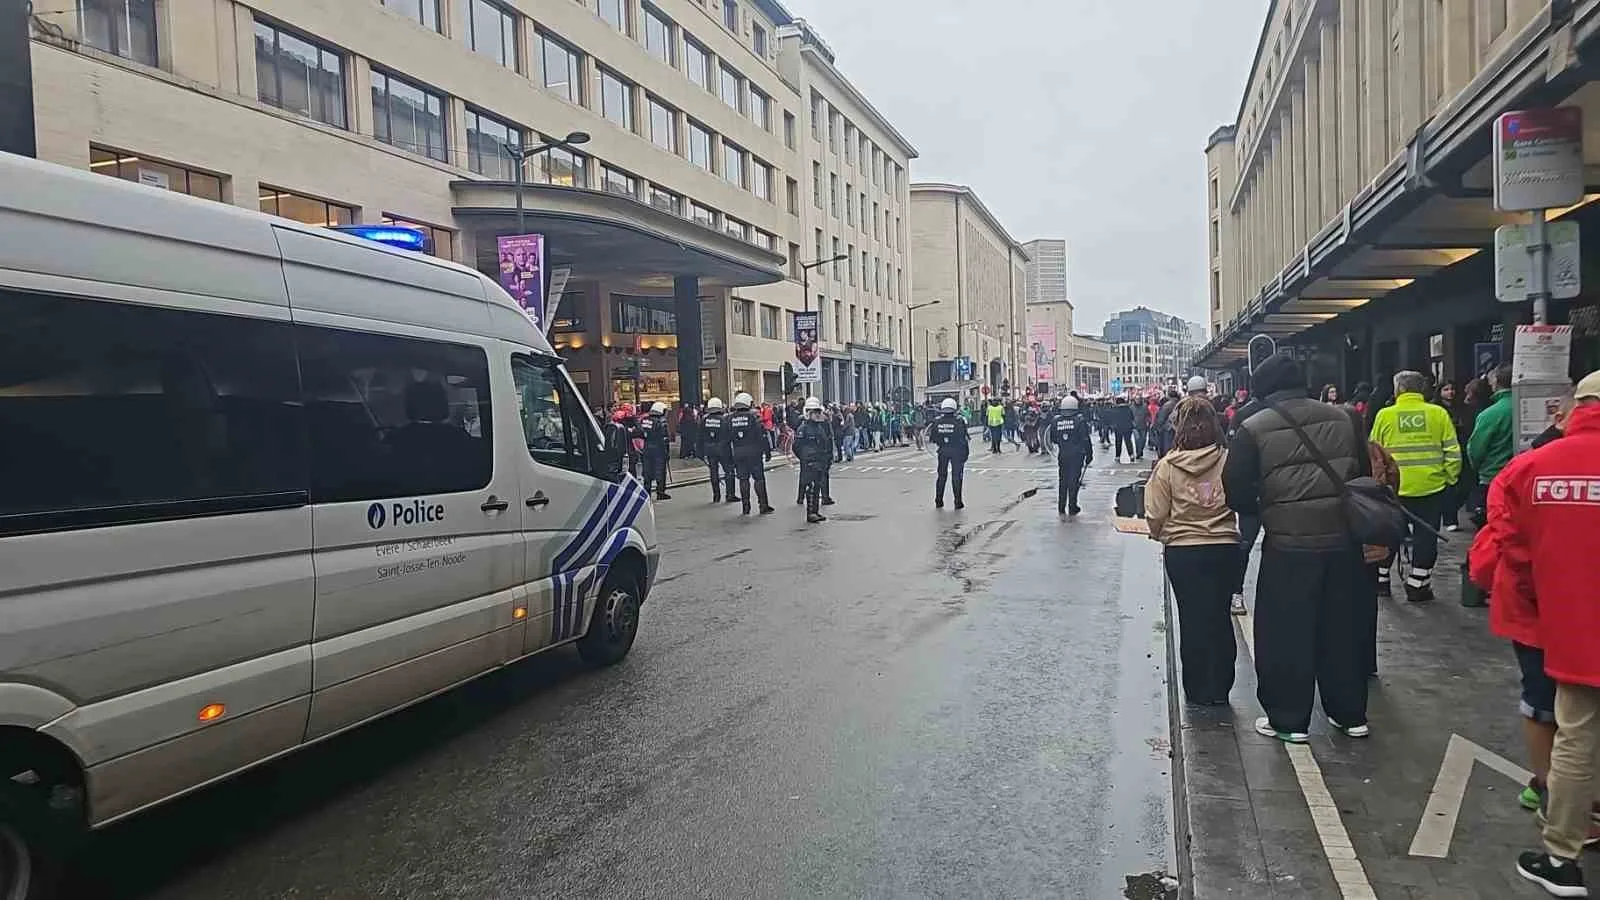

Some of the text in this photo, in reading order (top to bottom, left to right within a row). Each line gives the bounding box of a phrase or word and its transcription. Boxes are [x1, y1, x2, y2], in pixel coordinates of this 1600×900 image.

[1399, 414, 1425, 428] KC
[393, 499, 444, 526] Police
[375, 543, 401, 557] Evere
